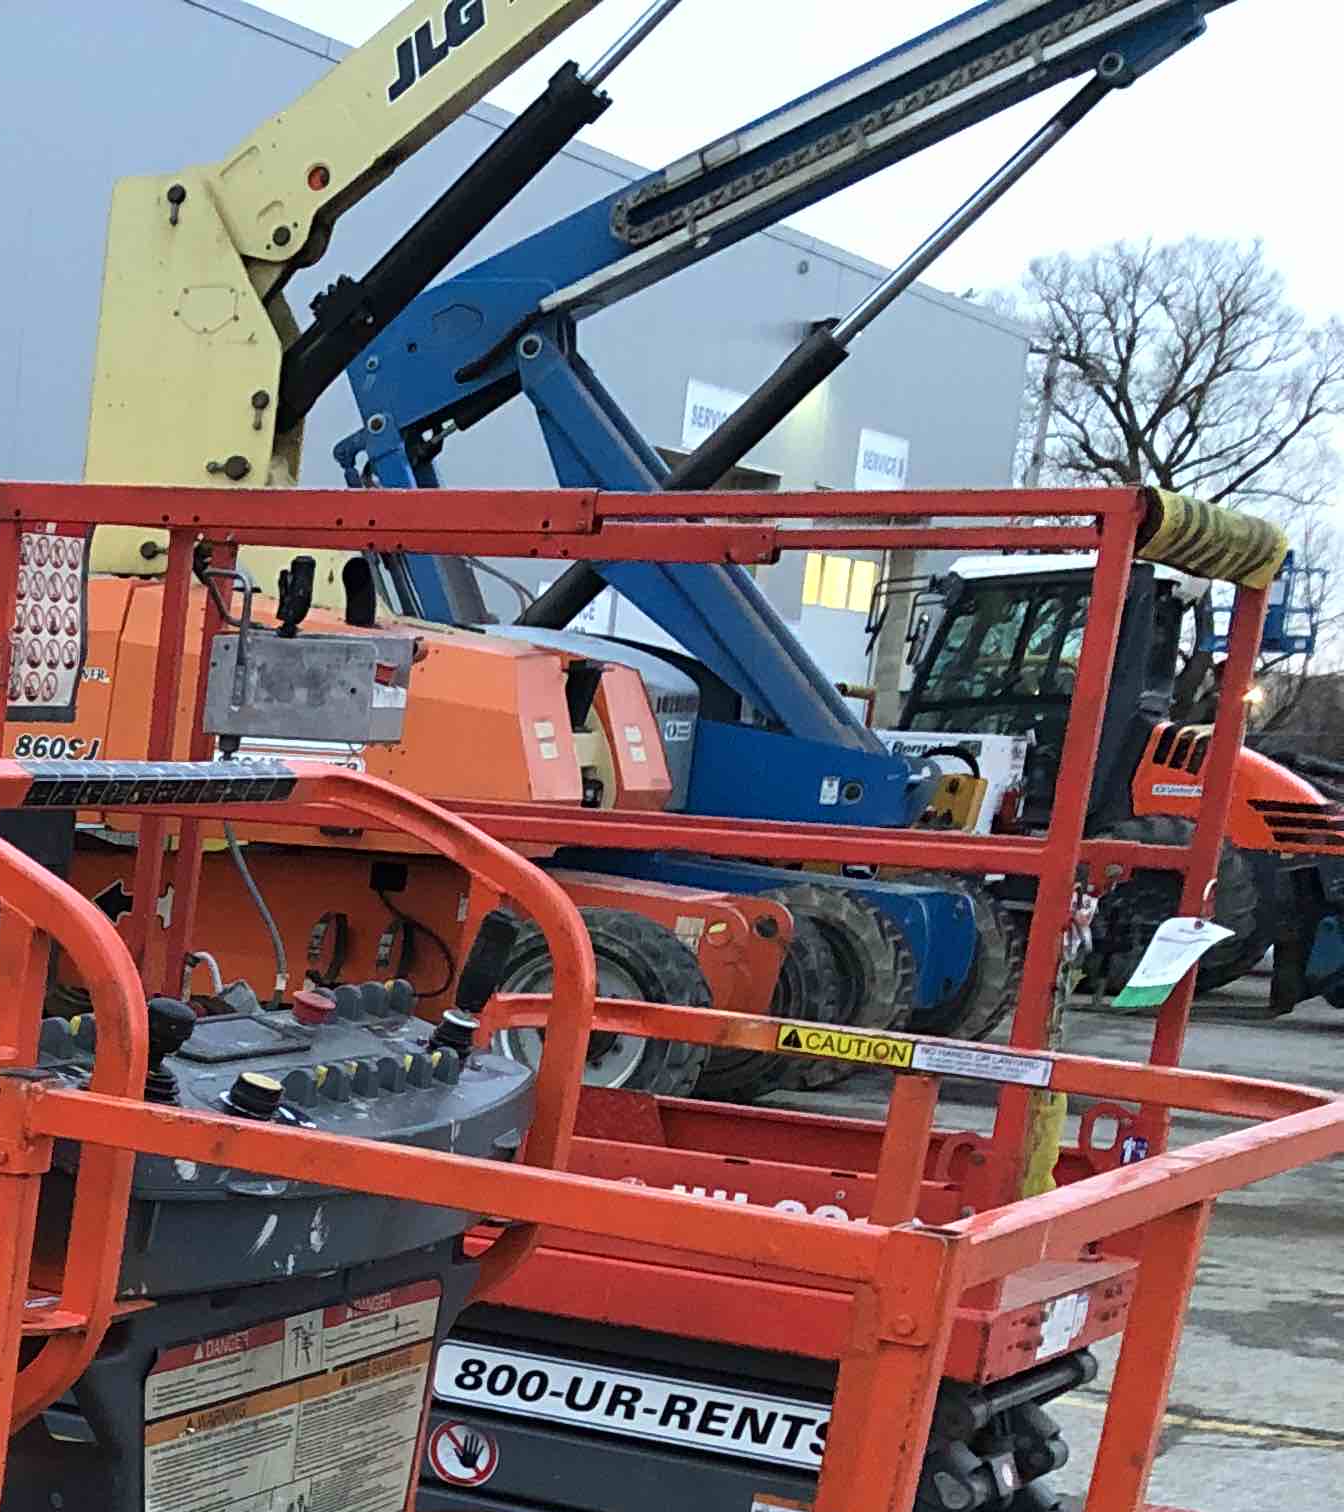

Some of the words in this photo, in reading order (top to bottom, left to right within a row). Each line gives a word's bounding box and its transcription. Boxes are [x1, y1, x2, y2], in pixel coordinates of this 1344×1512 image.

[388, 0, 487, 103] JLG
[690, 403, 728, 433] SERVI
[805, 1031, 910, 1064] CAUTION
